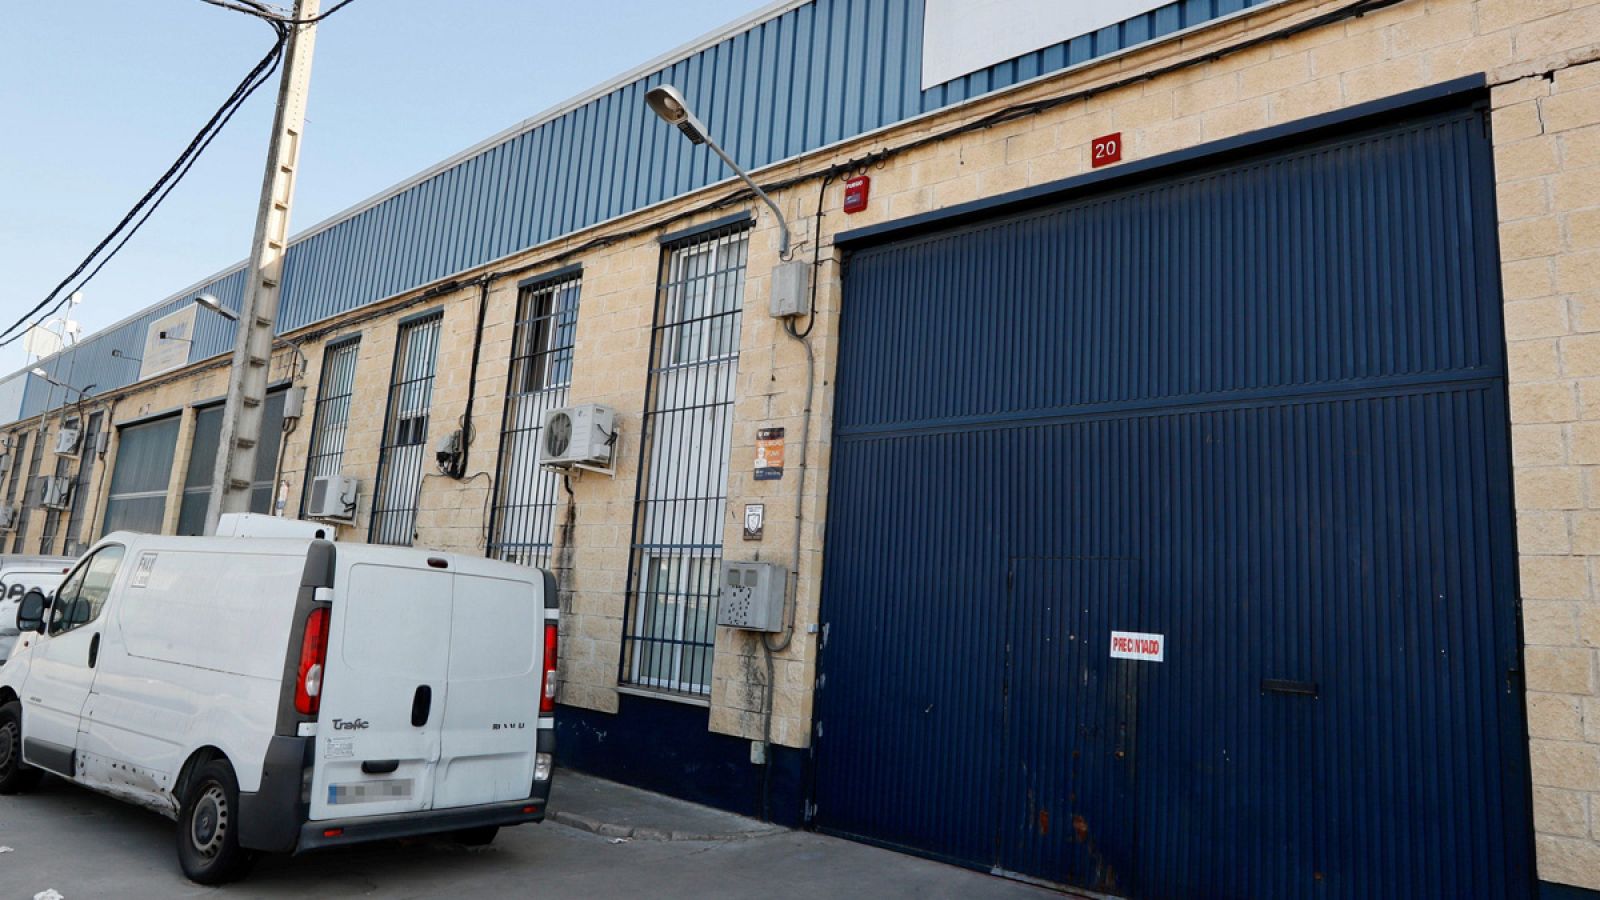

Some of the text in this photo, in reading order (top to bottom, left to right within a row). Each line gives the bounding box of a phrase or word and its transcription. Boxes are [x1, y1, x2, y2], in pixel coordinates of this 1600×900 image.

[1095, 141, 1117, 159] 20
[1112, 637, 1160, 655] PRECNTADO
[332, 718, 369, 731] Trafic
